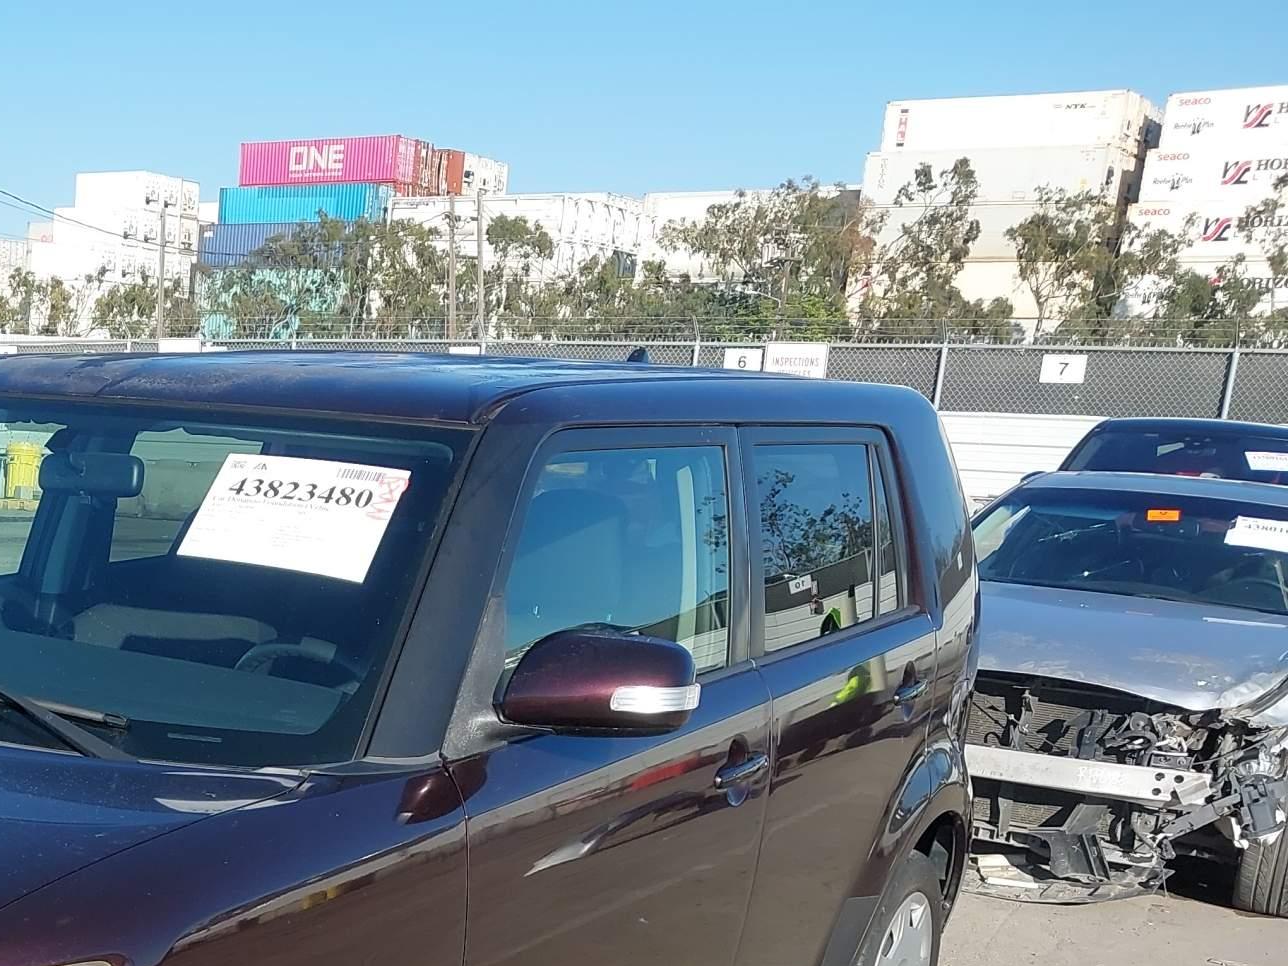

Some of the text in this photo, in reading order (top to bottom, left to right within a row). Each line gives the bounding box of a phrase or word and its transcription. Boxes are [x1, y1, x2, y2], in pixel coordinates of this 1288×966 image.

[1178, 98, 1211, 107] seaco
[289, 145, 345, 170] ONE
[1157, 152, 1190, 162] seaco
[1138, 207, 1171, 217] seaco
[738, 355, 747, 369] 6
[771, 355, 820, 368] INSPECTIONS
[1058, 361, 1070, 376] 7
[227, 477, 374, 509] 43823480
